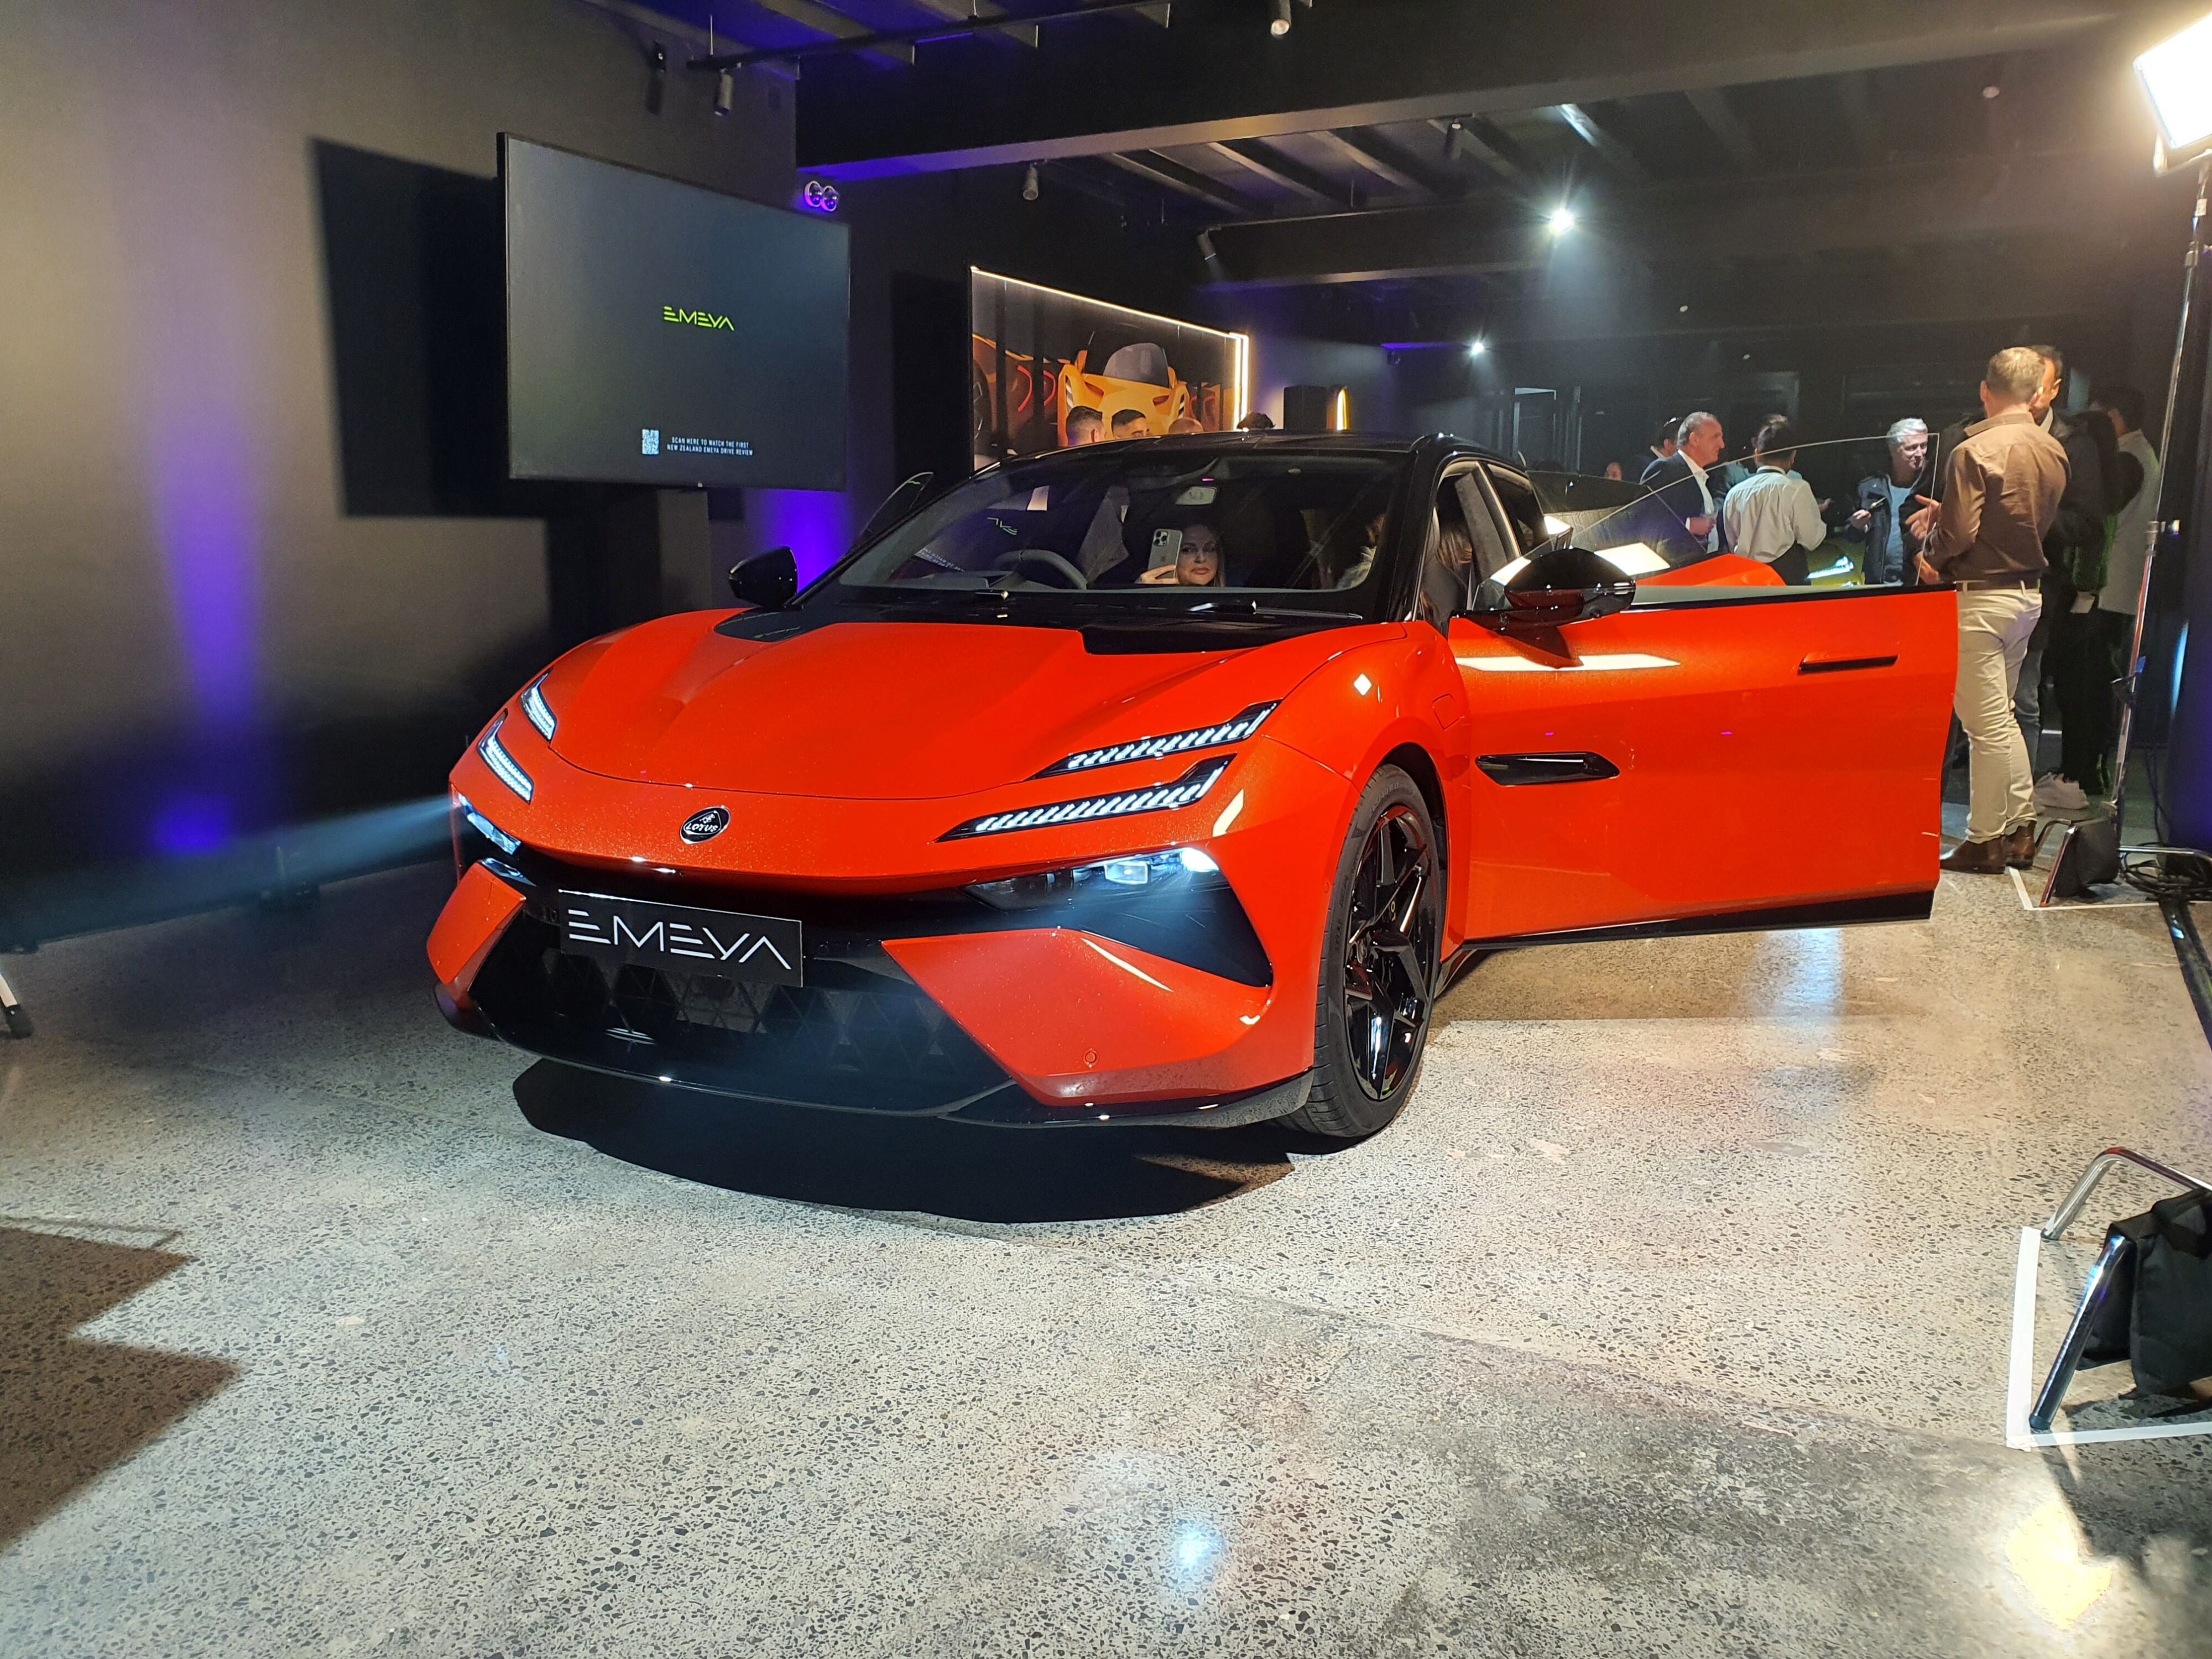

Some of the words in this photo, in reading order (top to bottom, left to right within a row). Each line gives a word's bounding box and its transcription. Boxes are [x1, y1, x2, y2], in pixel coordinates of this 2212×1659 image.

[664, 306, 735, 331] EMEYA
[685, 822, 718, 832] LOTUS
[568, 909, 792, 970] EMEYA
